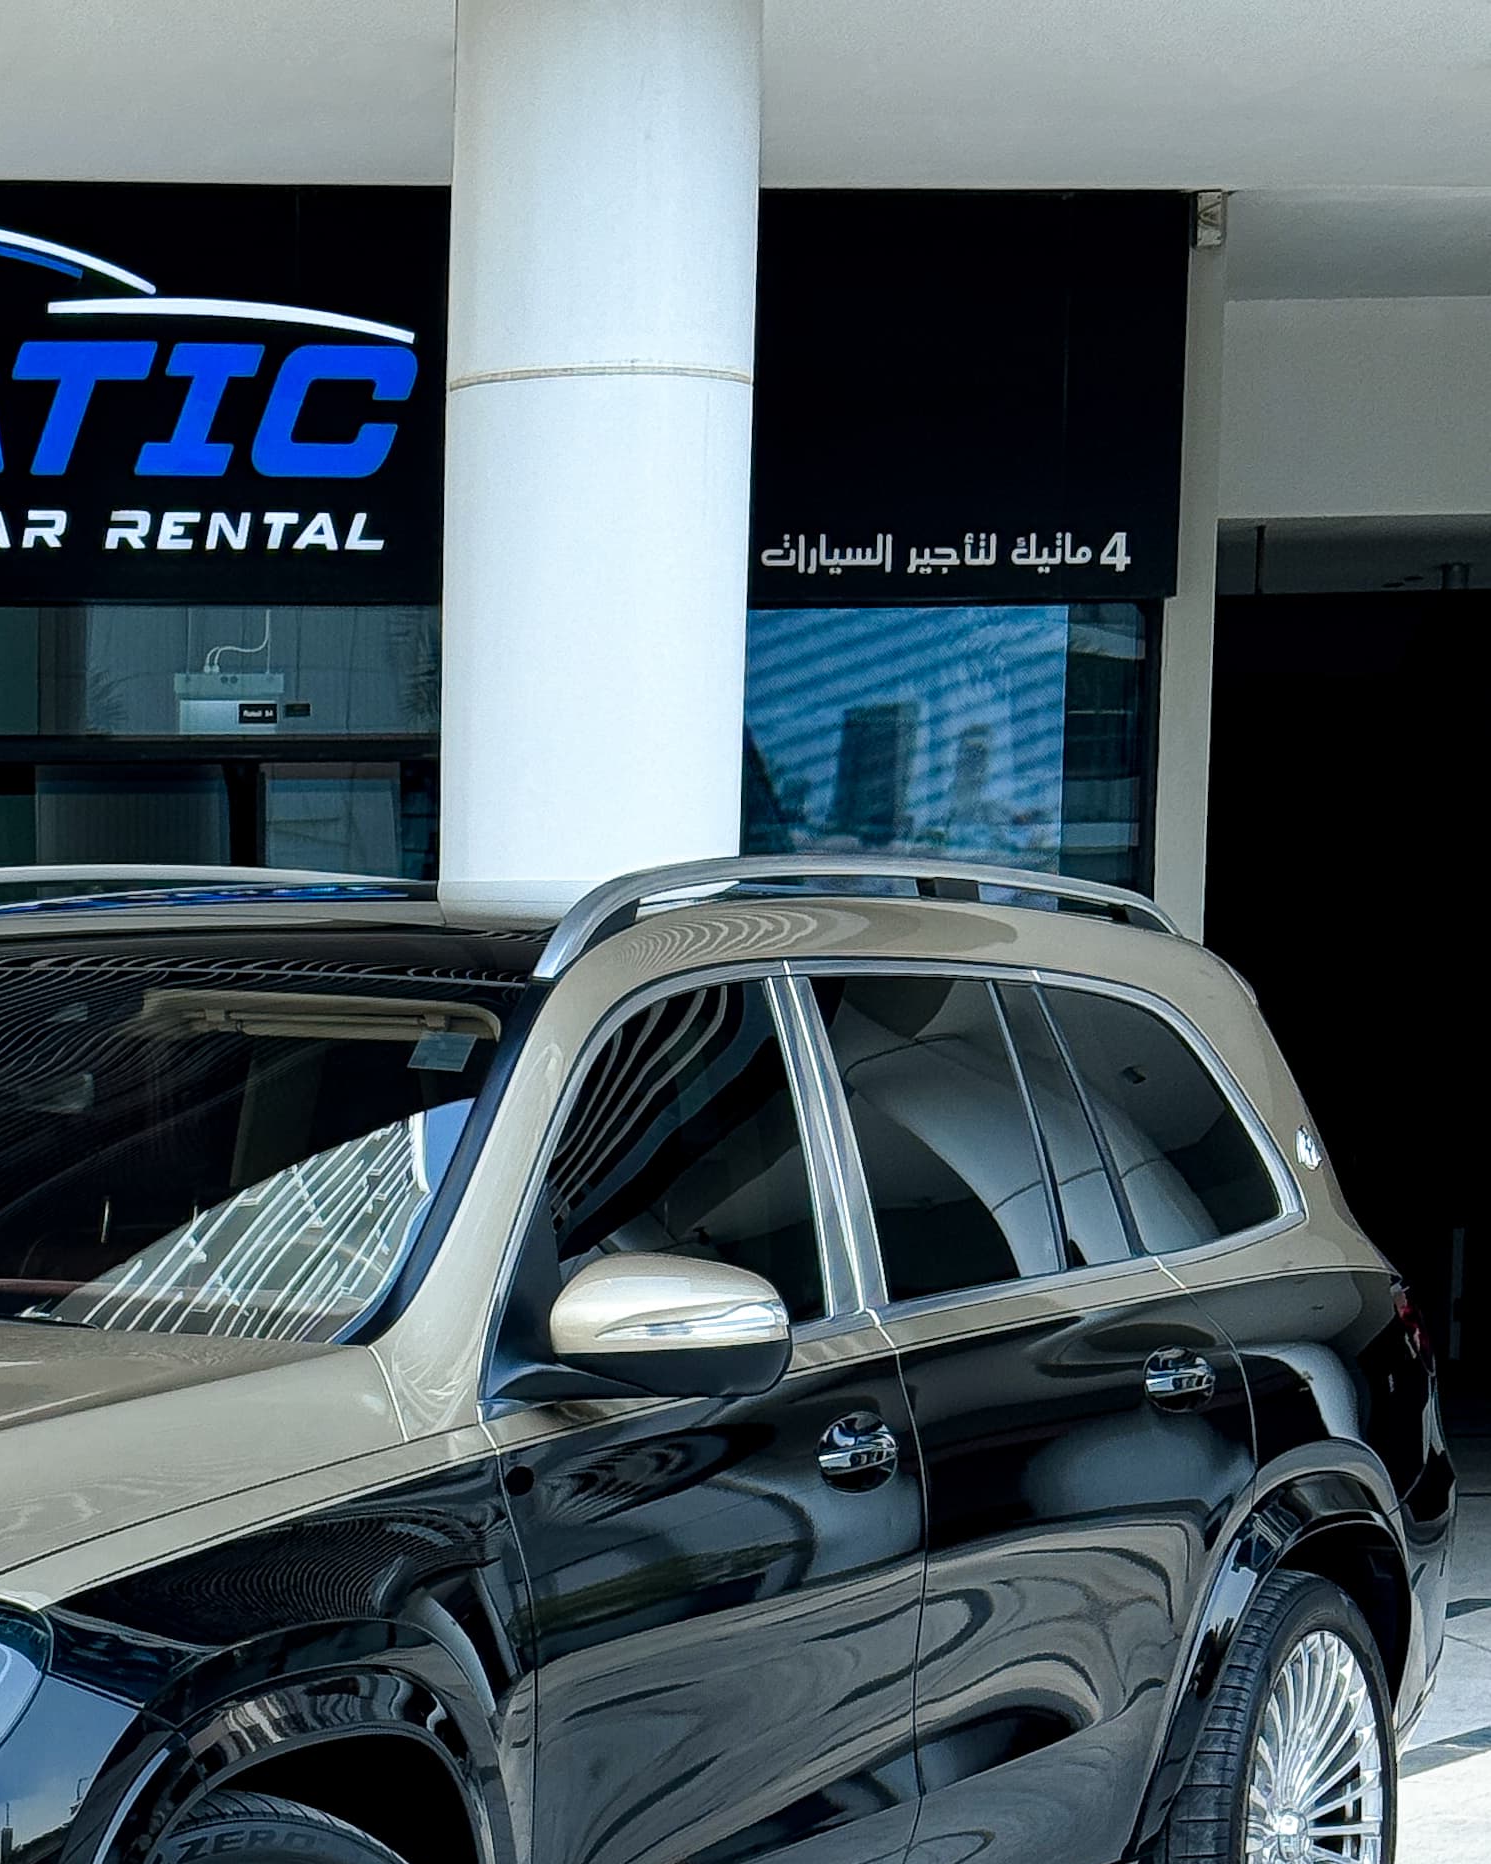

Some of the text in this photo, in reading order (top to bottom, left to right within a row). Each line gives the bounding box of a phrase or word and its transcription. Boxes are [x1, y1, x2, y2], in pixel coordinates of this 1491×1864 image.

[104, 509, 385, 551] RENTAL
[761, 531, 1132, 575] 4 ماتيك لتأجير السيارات
[177, 1829, 317, 1864] ZERO
